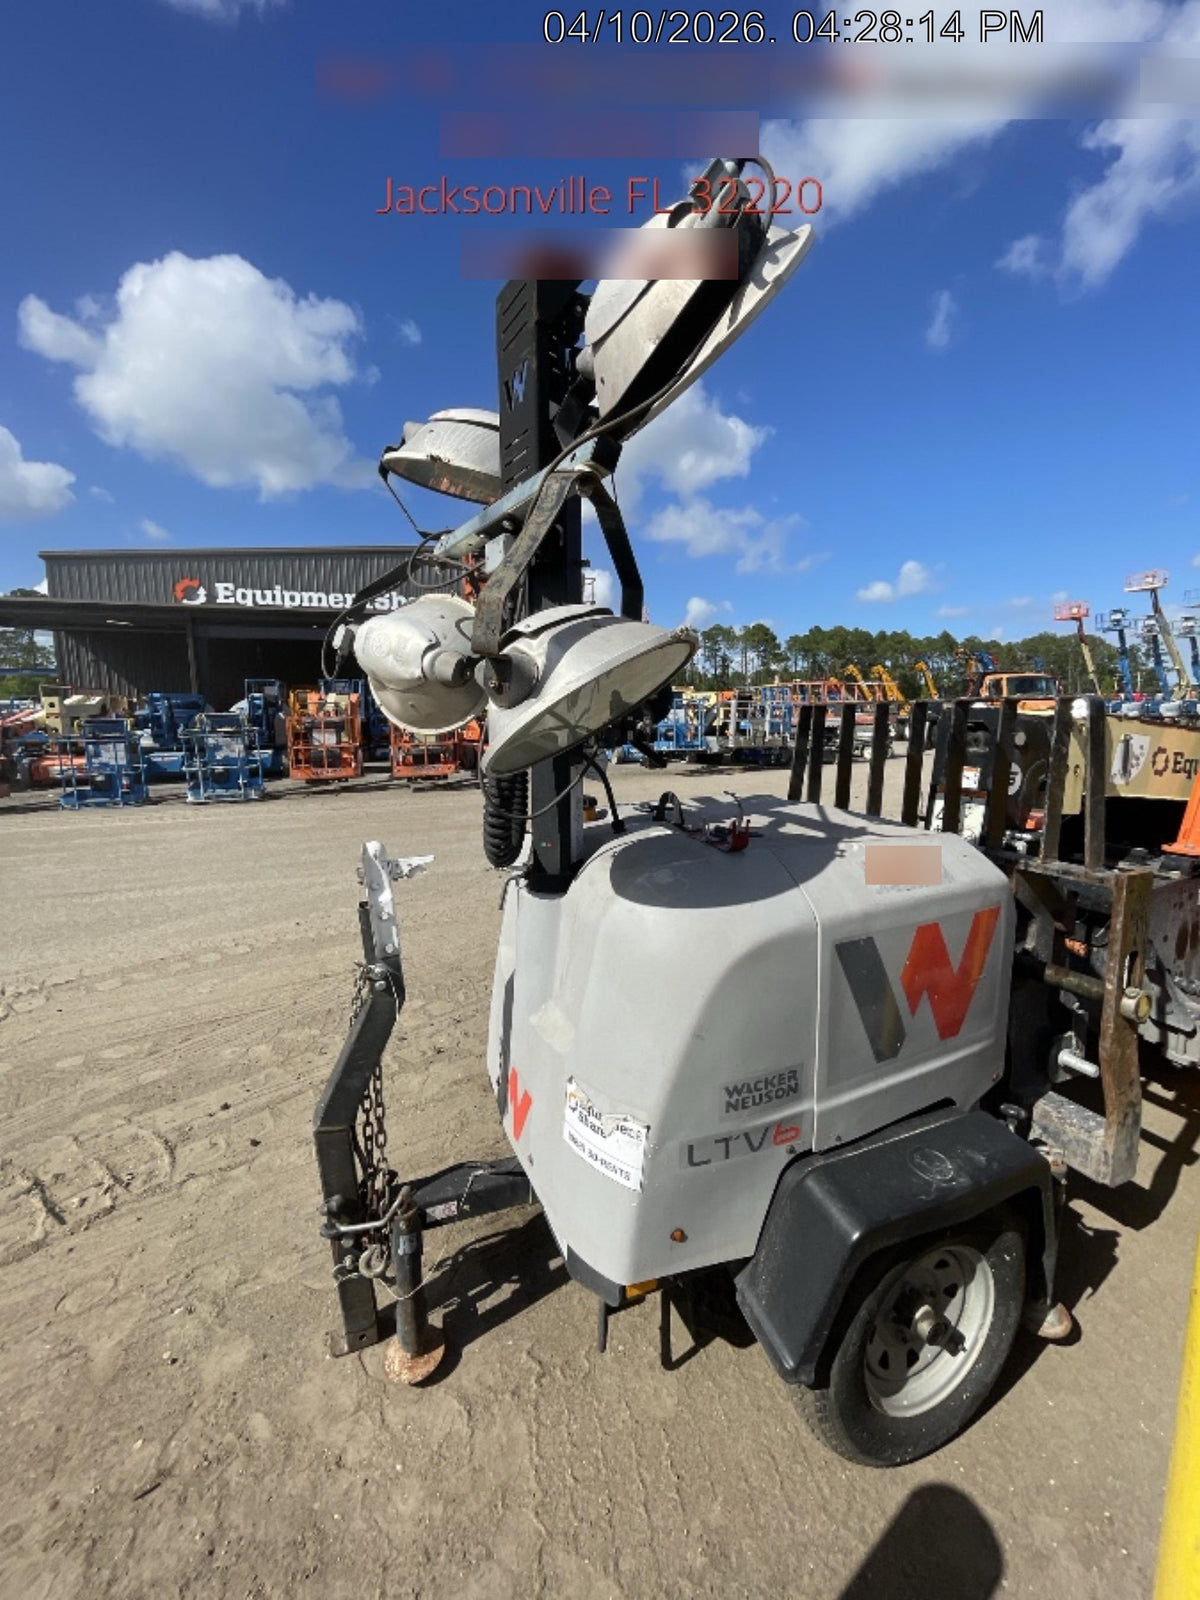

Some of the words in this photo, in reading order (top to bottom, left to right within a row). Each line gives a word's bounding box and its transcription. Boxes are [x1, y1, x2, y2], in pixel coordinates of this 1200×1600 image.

[724, 1069, 798, 1099] WACKER
[725, 1082, 799, 1113] NEUSON
[688, 1120, 801, 1167] LTV6
